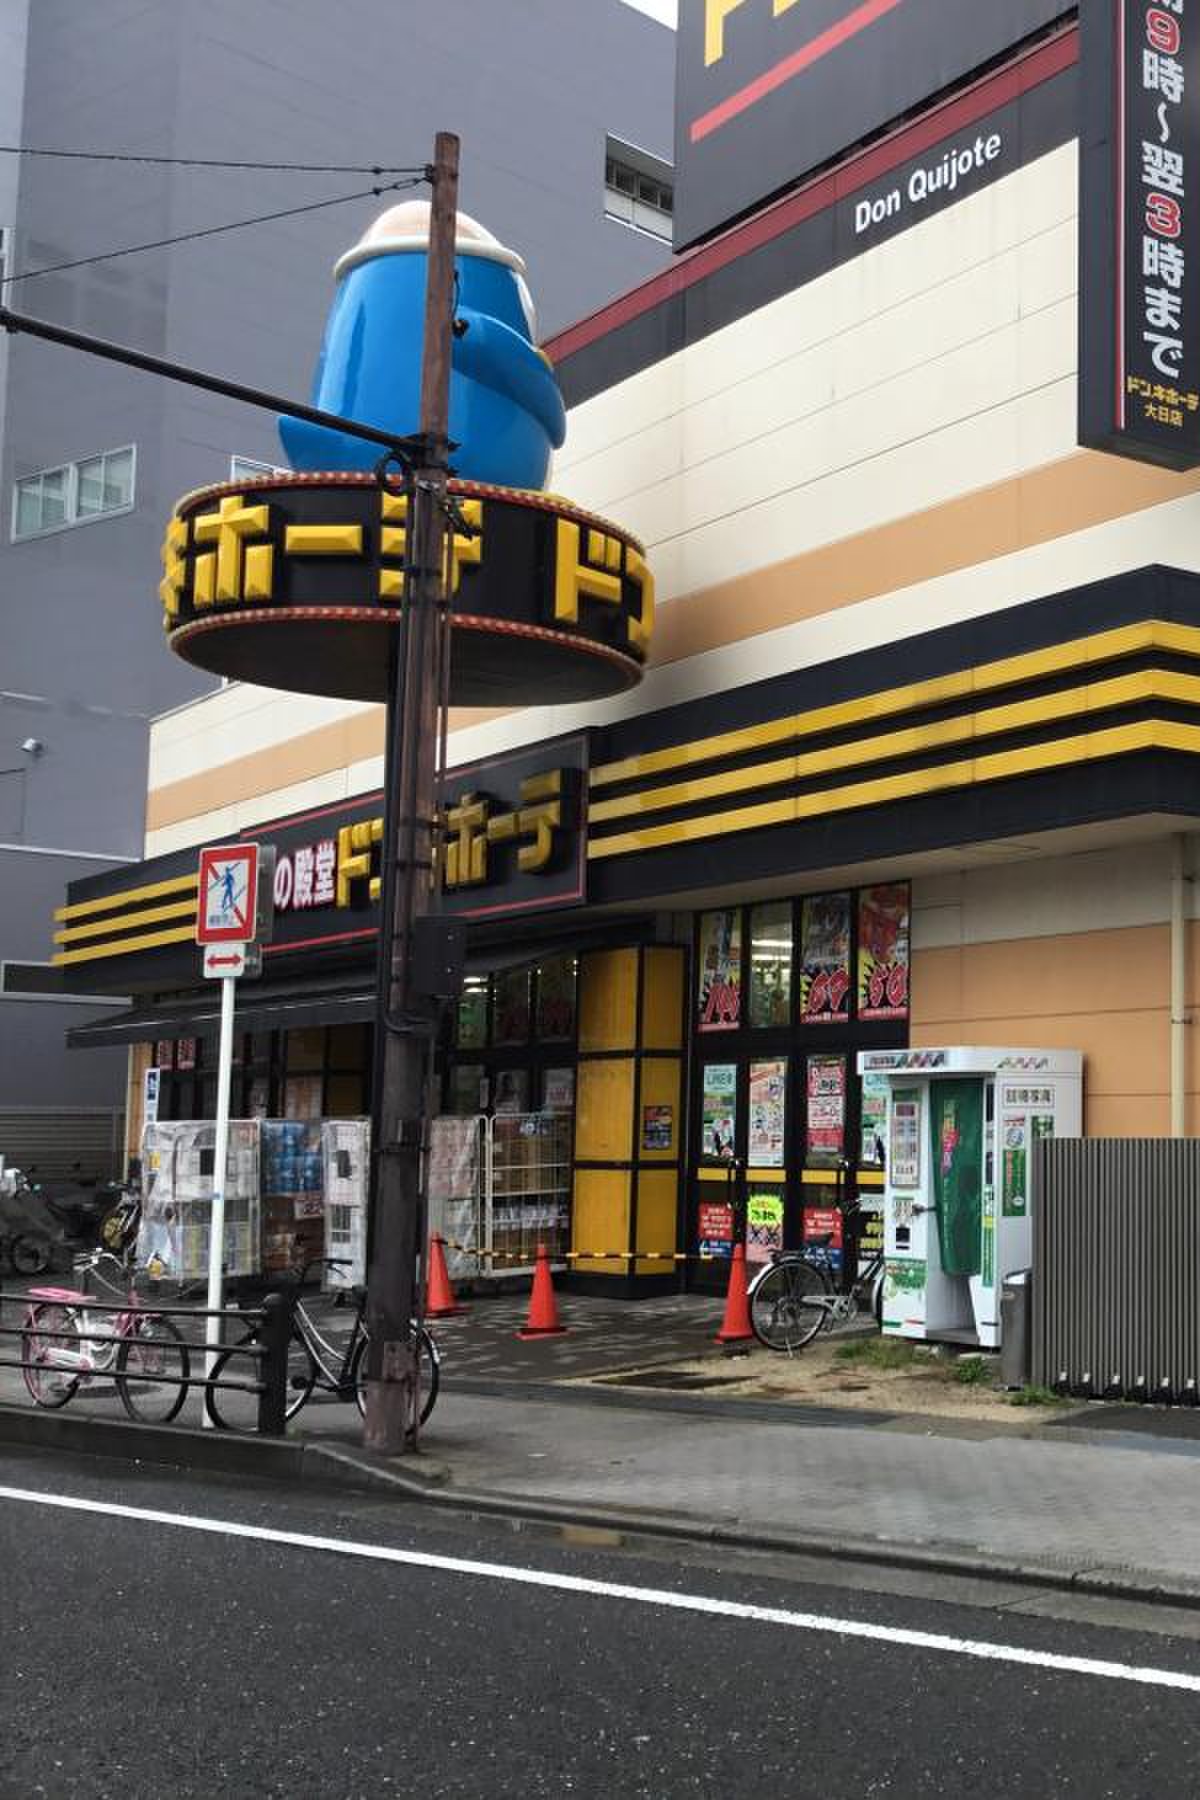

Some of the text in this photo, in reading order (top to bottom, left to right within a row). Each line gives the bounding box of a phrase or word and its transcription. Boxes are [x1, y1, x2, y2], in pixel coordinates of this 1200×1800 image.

[854, 133, 1002, 234] Don Quijote
[1144, 403, 1184, 428] 大日店
